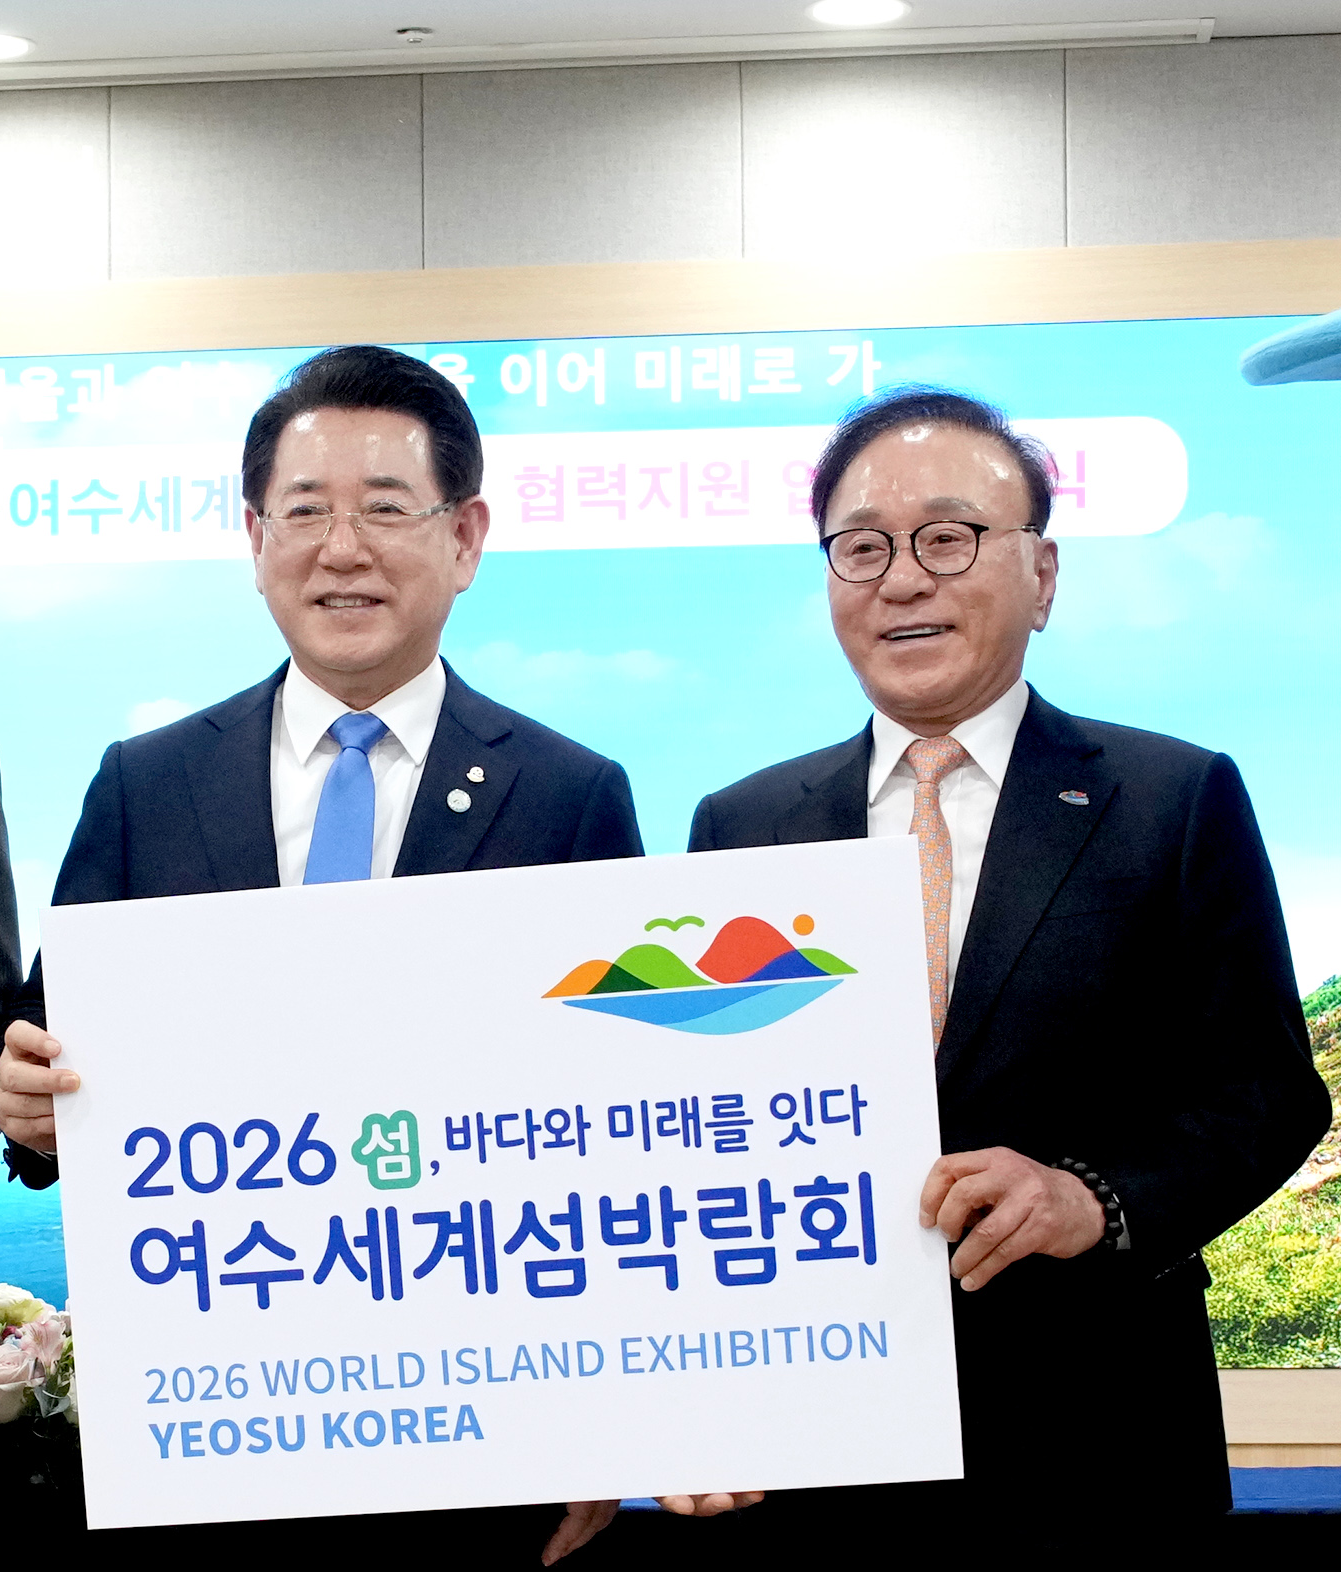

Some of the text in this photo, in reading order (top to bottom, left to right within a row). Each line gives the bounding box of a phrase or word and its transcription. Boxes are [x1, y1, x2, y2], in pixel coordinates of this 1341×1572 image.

[500, 347, 605, 407] 이어
[635, 344, 802, 403] 미래로
[514, 459, 751, 524] 협력지원
[123, 1112, 337, 1199] 2026
[607, 1093, 755, 1154] 미래를
[769, 1083, 868, 1148] 잇다
[128, 1170, 879, 1313] 여수세계섬박람회
[144, 1320, 889, 1405] 2026 WORLD ISLAND EXHIBITION
[148, 1403, 485, 1460] YEOSU KOREA
